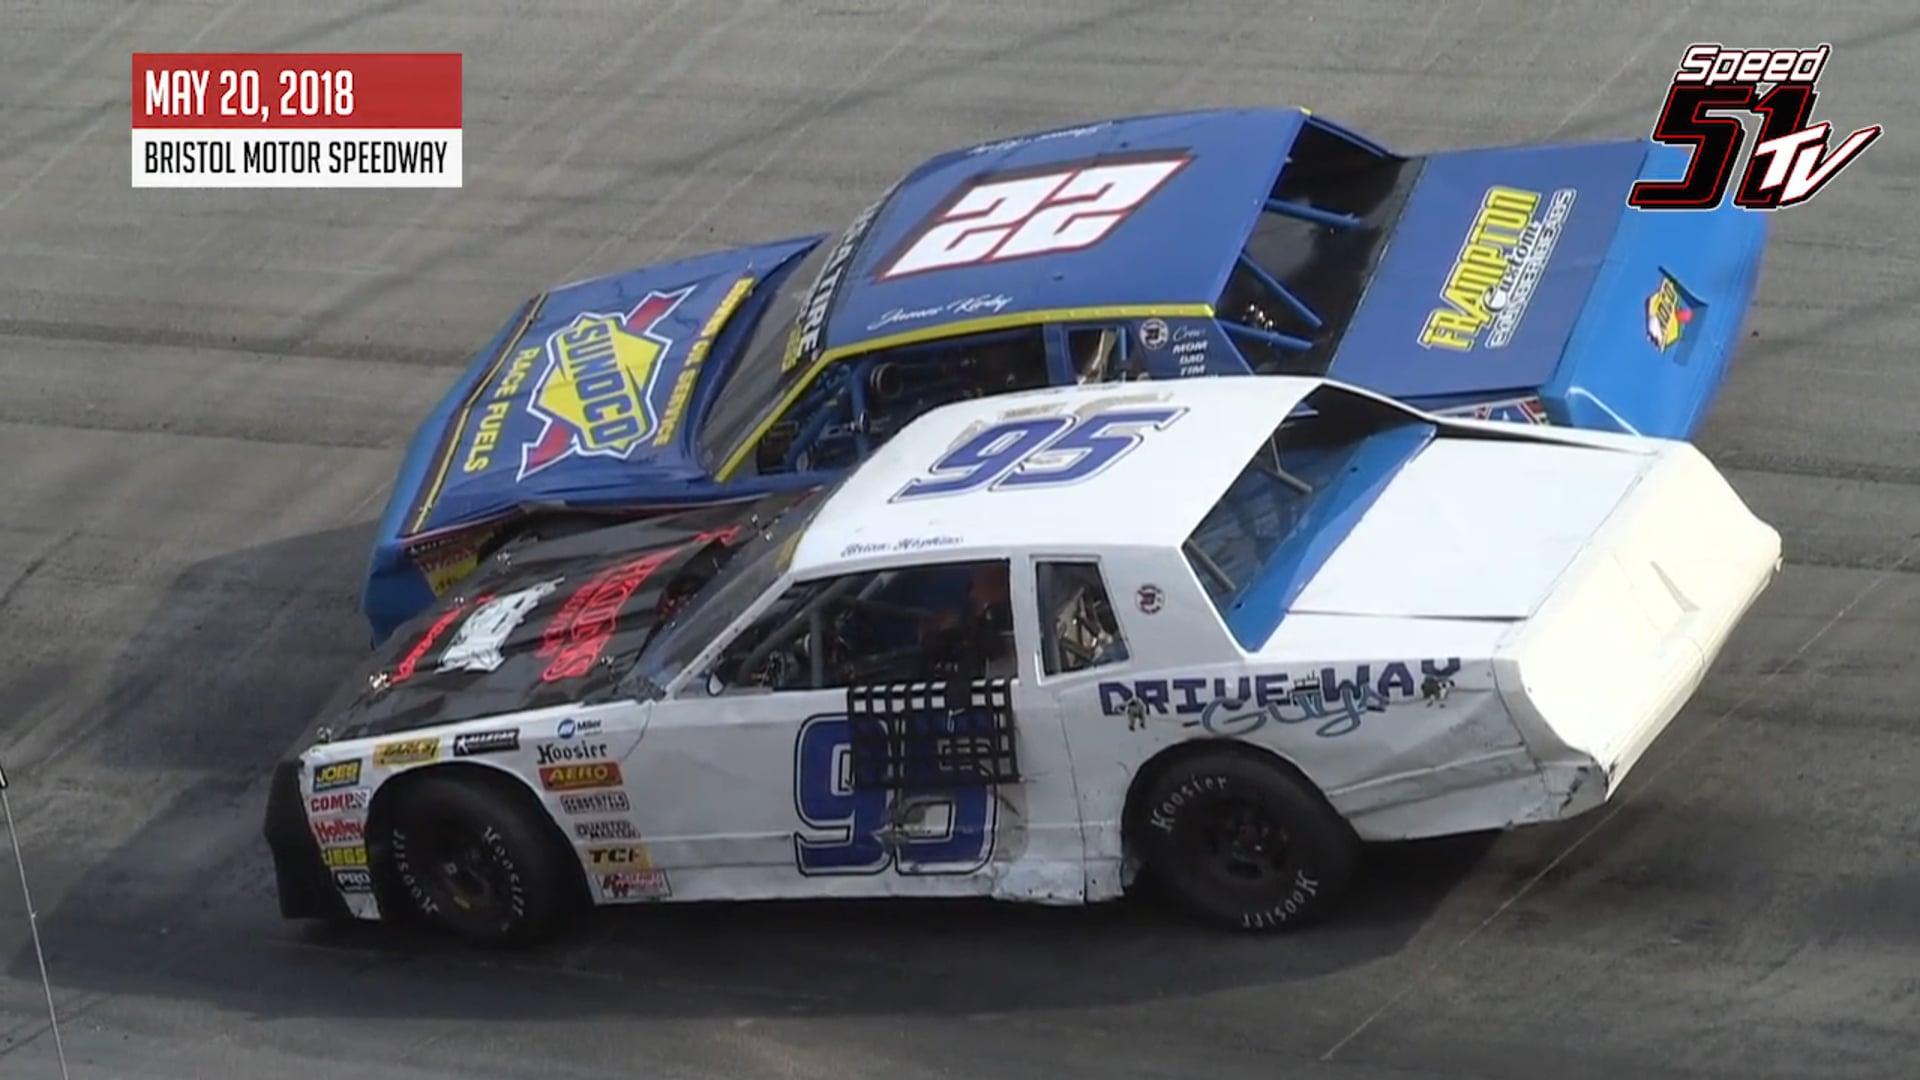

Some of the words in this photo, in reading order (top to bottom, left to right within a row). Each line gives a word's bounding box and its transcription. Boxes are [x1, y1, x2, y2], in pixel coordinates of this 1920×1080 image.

[880, 156, 1194, 281] 22
[1421, 187, 1538, 349] FRAMPTON
[494, 347, 541, 399] RACE
[1173, 340, 1208, 354] MOM
[563, 322, 640, 446] SUNOCO
[463, 401, 510, 473] FUELS
[888, 407, 1190, 504] 95
[1099, 674, 1288, 716] DRIVE
[537, 740, 607, 765] Hoosier
[311, 792, 354, 812] COMP
[1151, 772, 1228, 833] Hoosier
